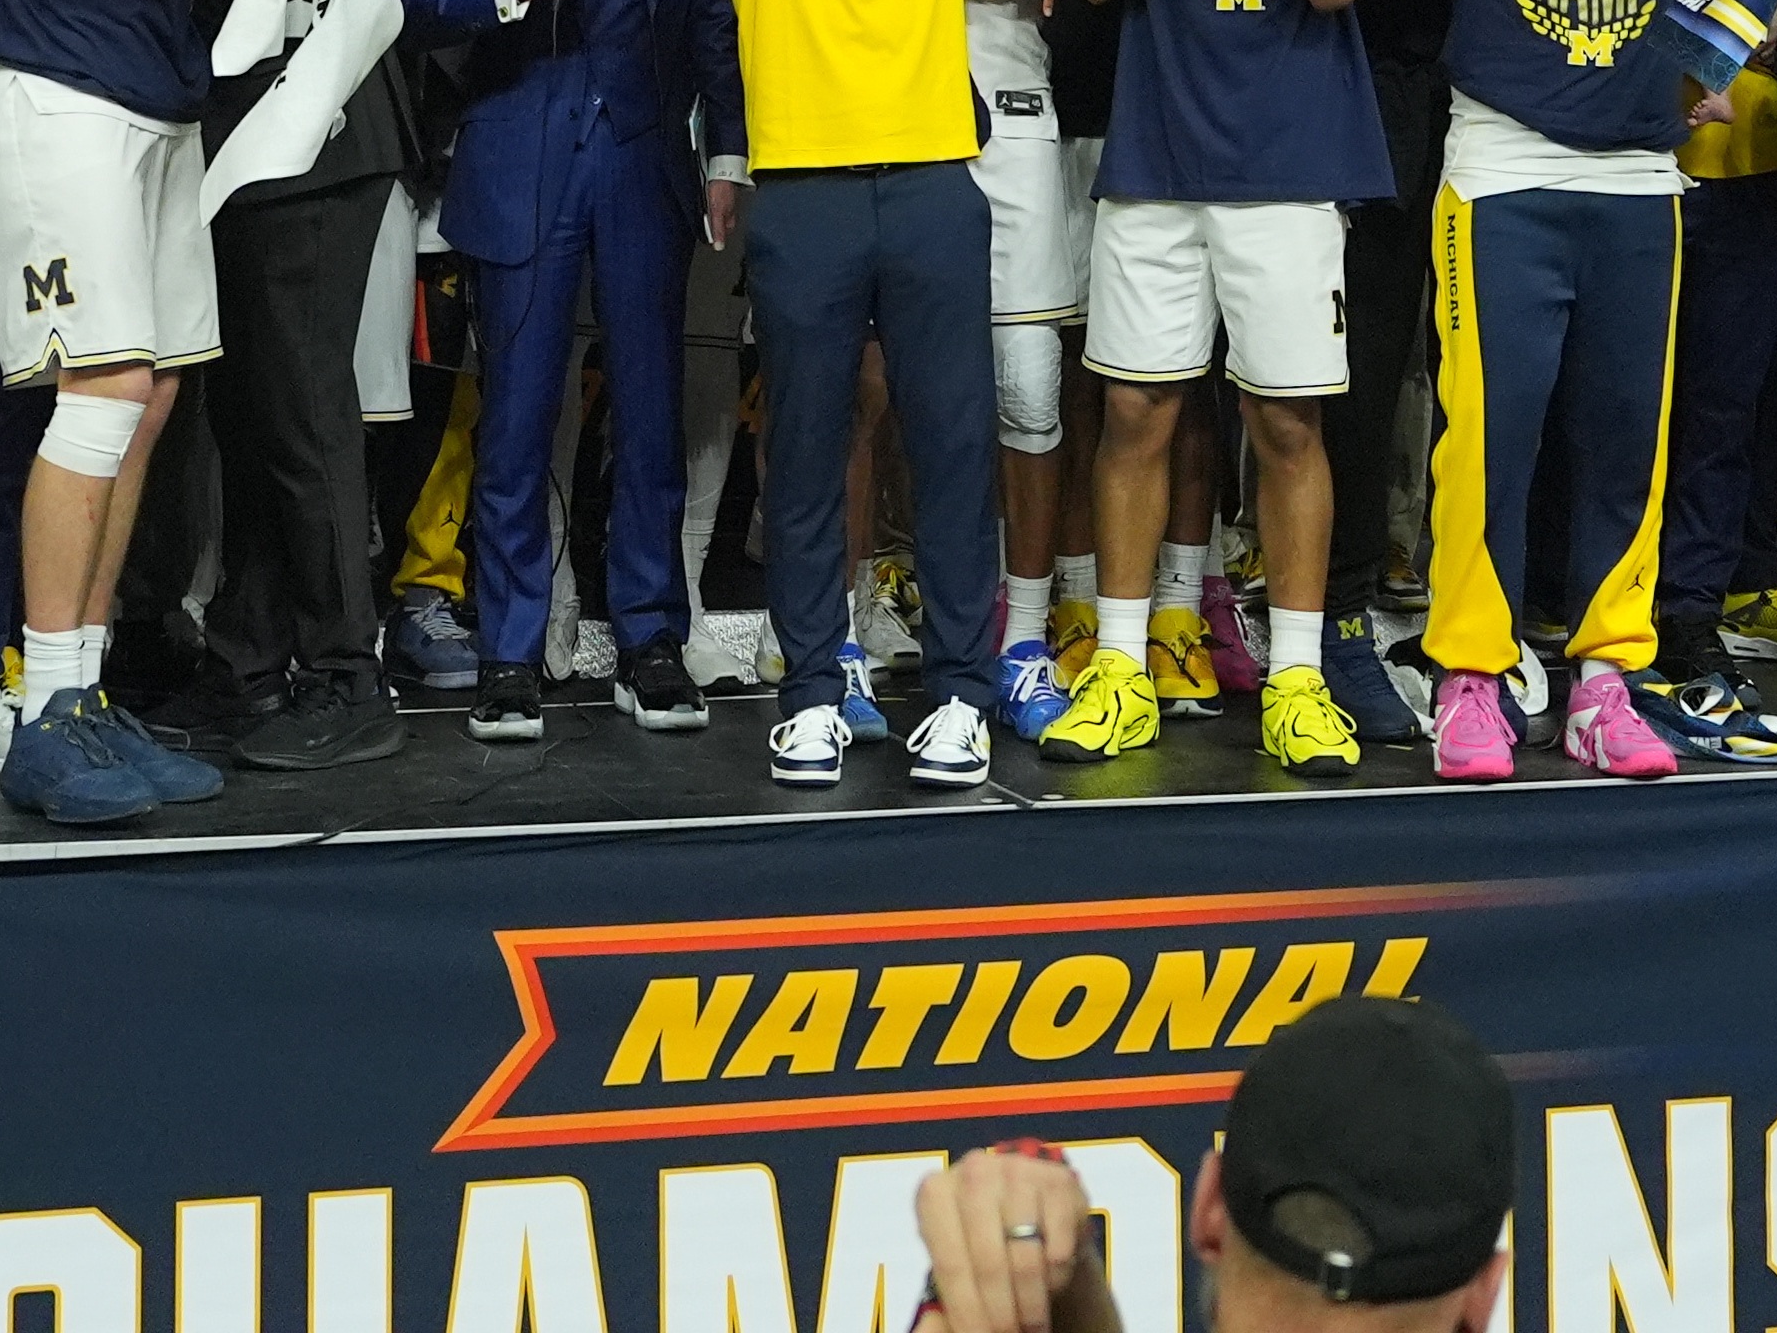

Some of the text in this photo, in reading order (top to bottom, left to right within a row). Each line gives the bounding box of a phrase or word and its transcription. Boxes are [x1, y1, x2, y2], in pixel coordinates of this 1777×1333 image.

[1567, 29, 1616, 67] M
[22, 257, 75, 314] M
[1446, 213, 1460, 332] MICHIGAN
[1337, 616, 1365, 640] M
